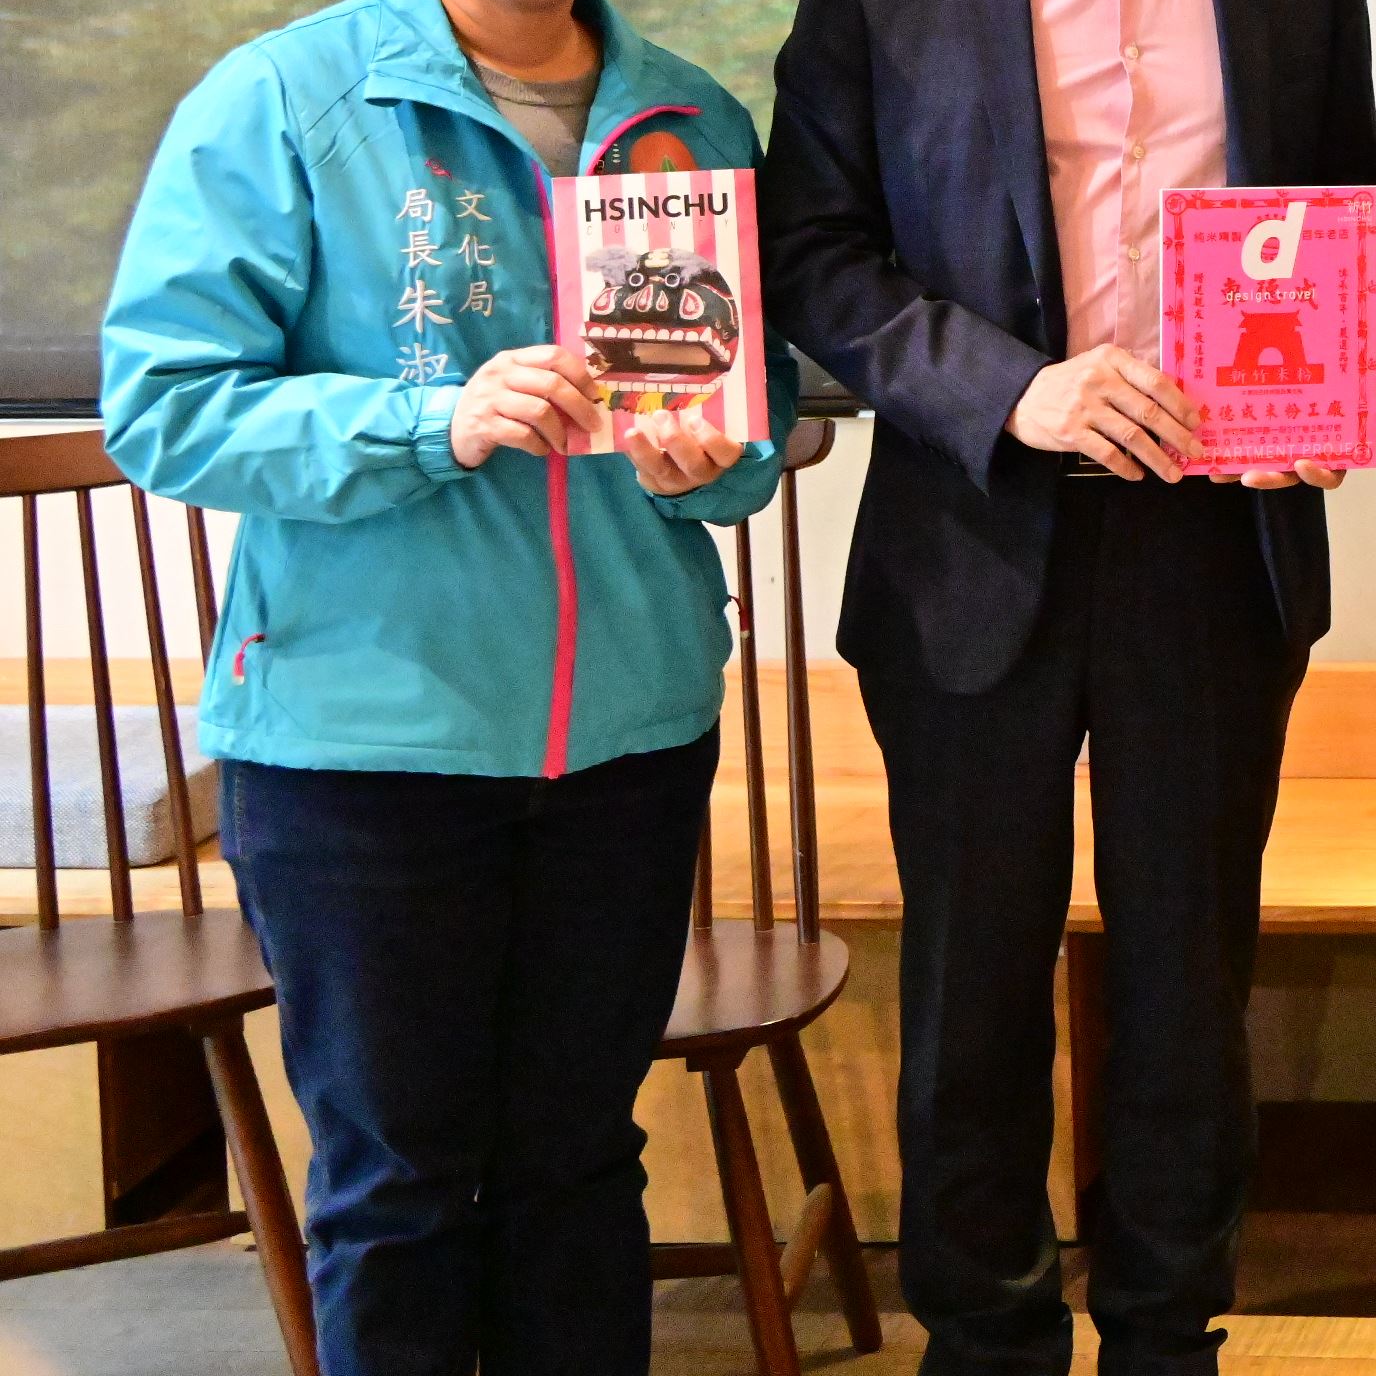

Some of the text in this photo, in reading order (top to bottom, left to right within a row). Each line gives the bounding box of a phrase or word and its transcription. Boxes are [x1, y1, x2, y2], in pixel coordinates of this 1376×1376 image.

[585, 193, 728, 222] HSINCHU
[1241, 202, 1307, 280] d
[456, 190, 496, 317] 文化局
[1227, 289, 1315, 303] design travel
[1232, 368, 1312, 383] 新竹米粉
[1202, 445, 1296, 459] EPARTMENT
